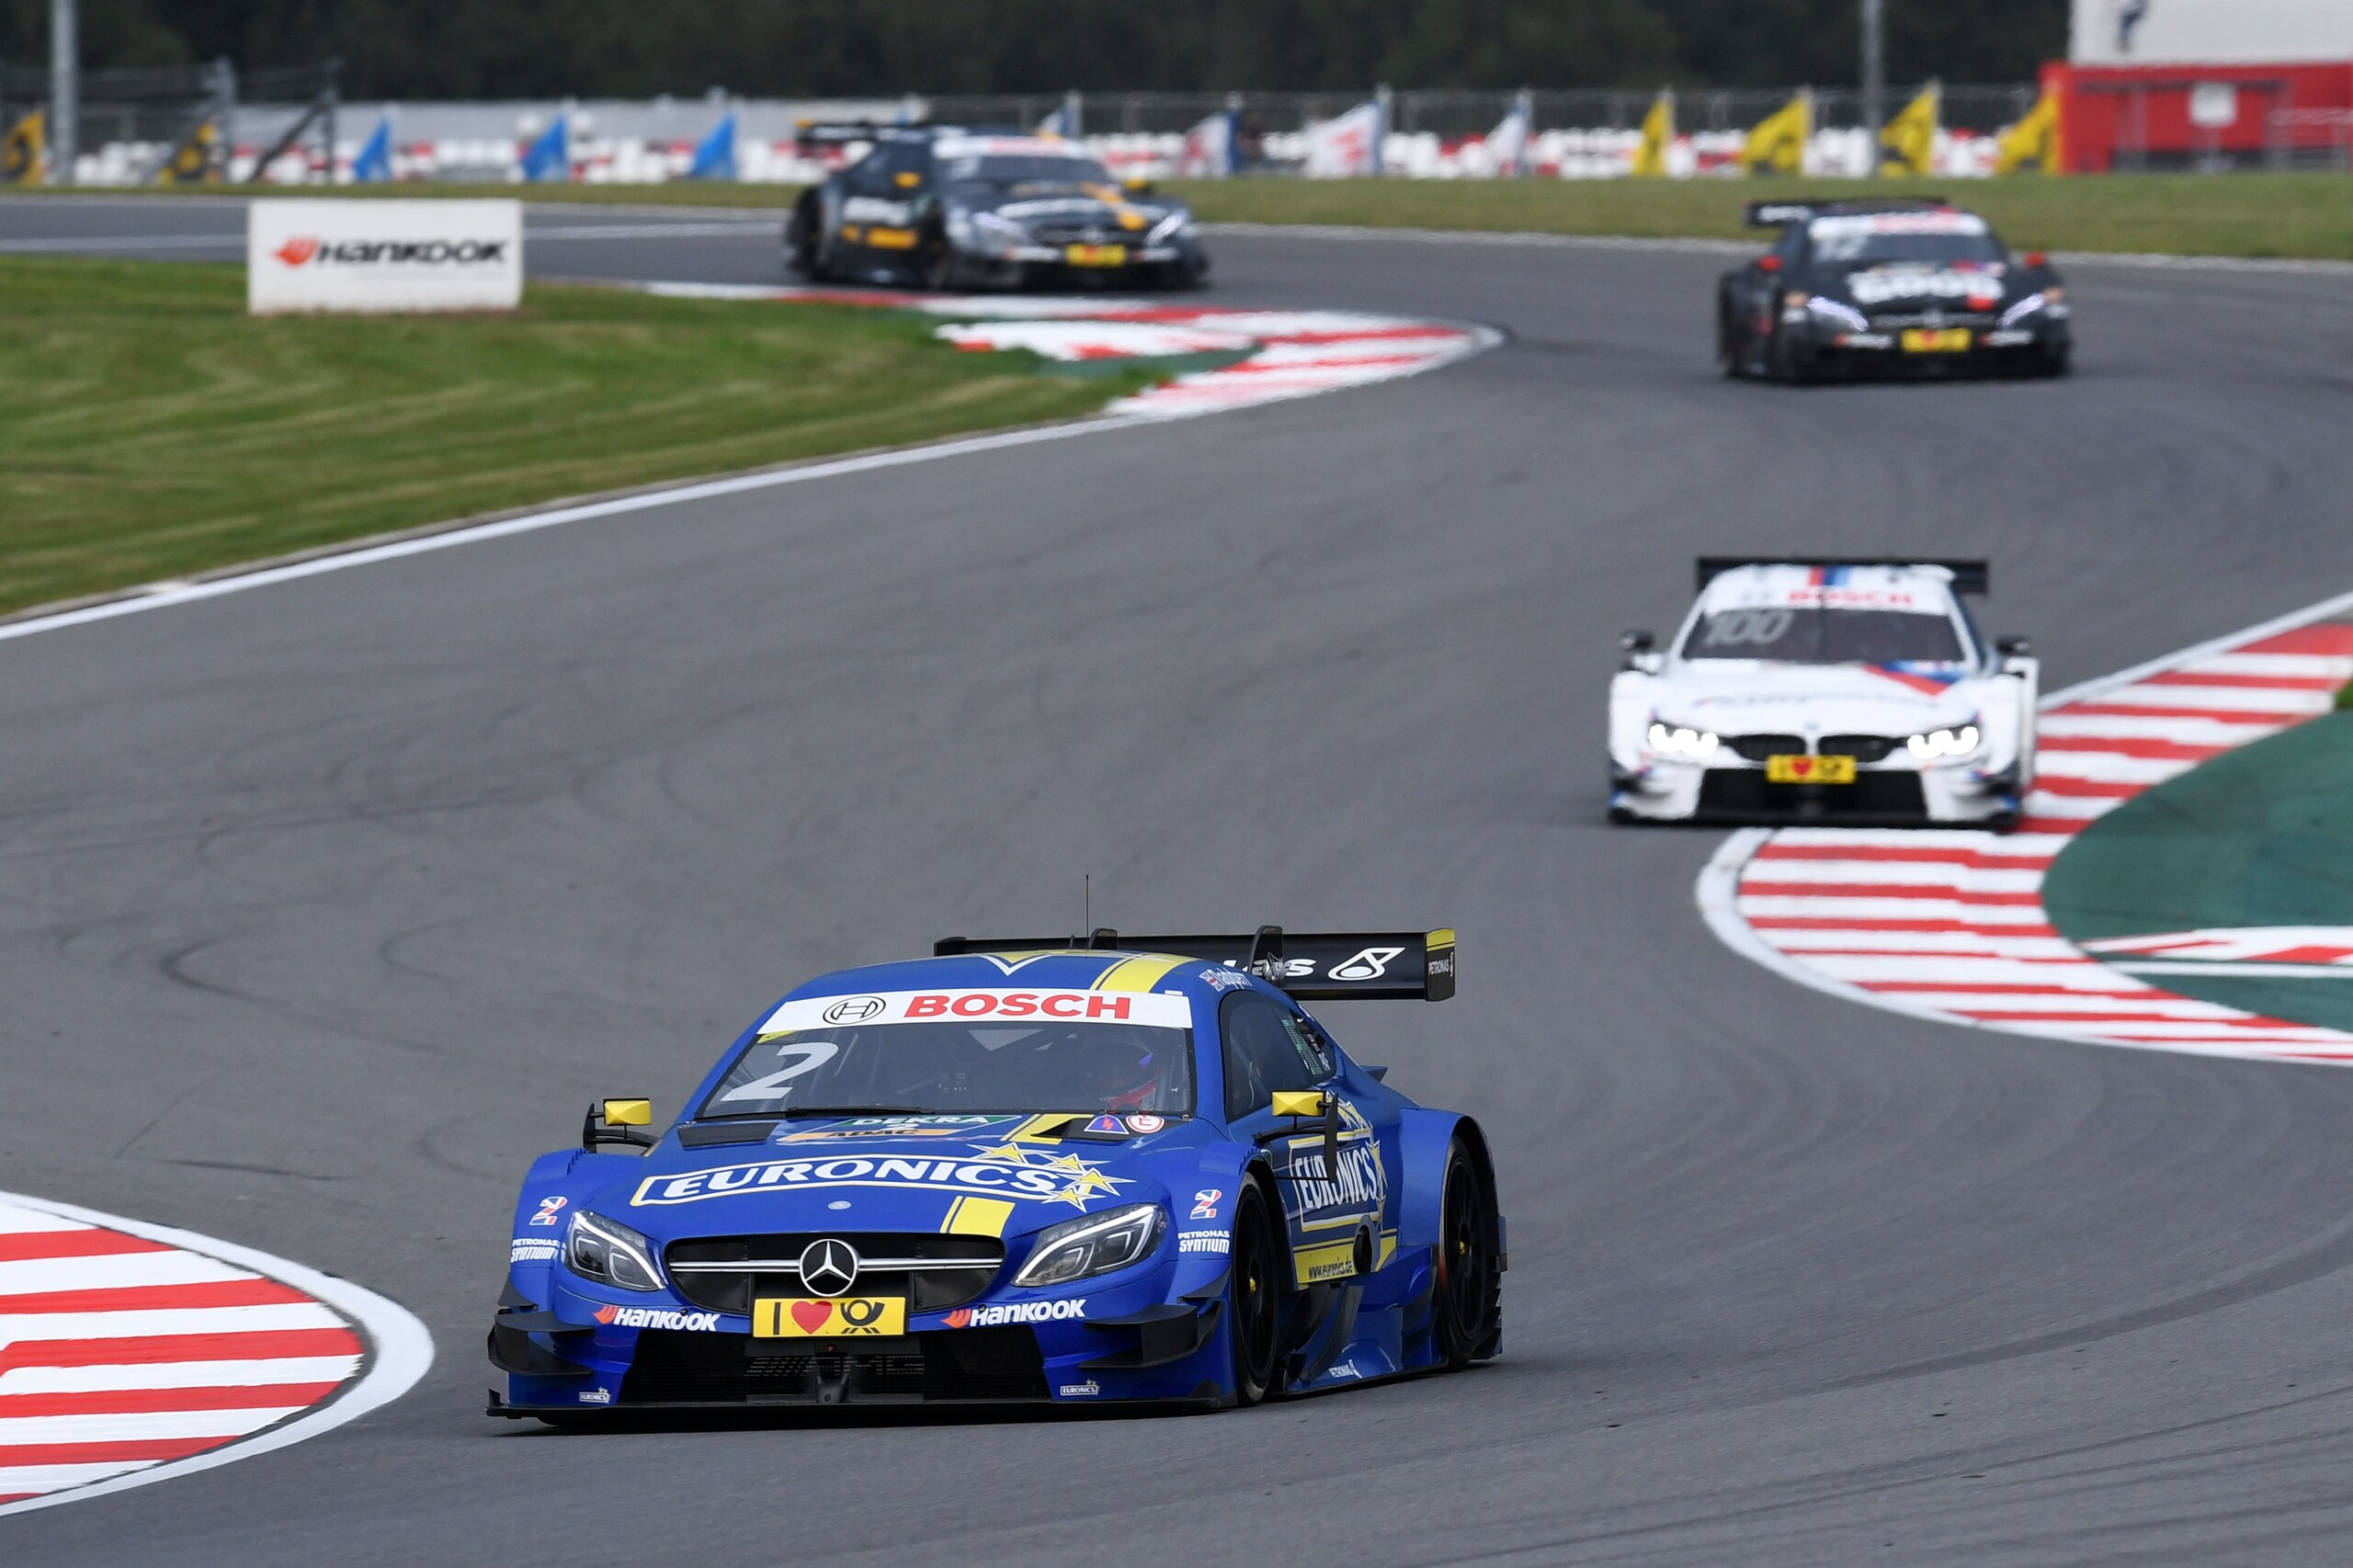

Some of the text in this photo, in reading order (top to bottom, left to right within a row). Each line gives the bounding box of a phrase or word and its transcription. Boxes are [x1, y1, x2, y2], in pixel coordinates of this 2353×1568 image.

[1704, 609, 1794, 645] 100
[904, 994, 1131, 1019] BOSCH
[720, 1042, 838, 1101] 2
[852, 1117, 989, 1125] DEKRA
[663, 1159, 1060, 1199] EURONICS
[529, 1196, 568, 1226] 2
[1190, 1189, 1222, 1220] 2
[512, 1237, 560, 1247] PETRONAS
[1178, 1230, 1230, 1239] PETRONAS
